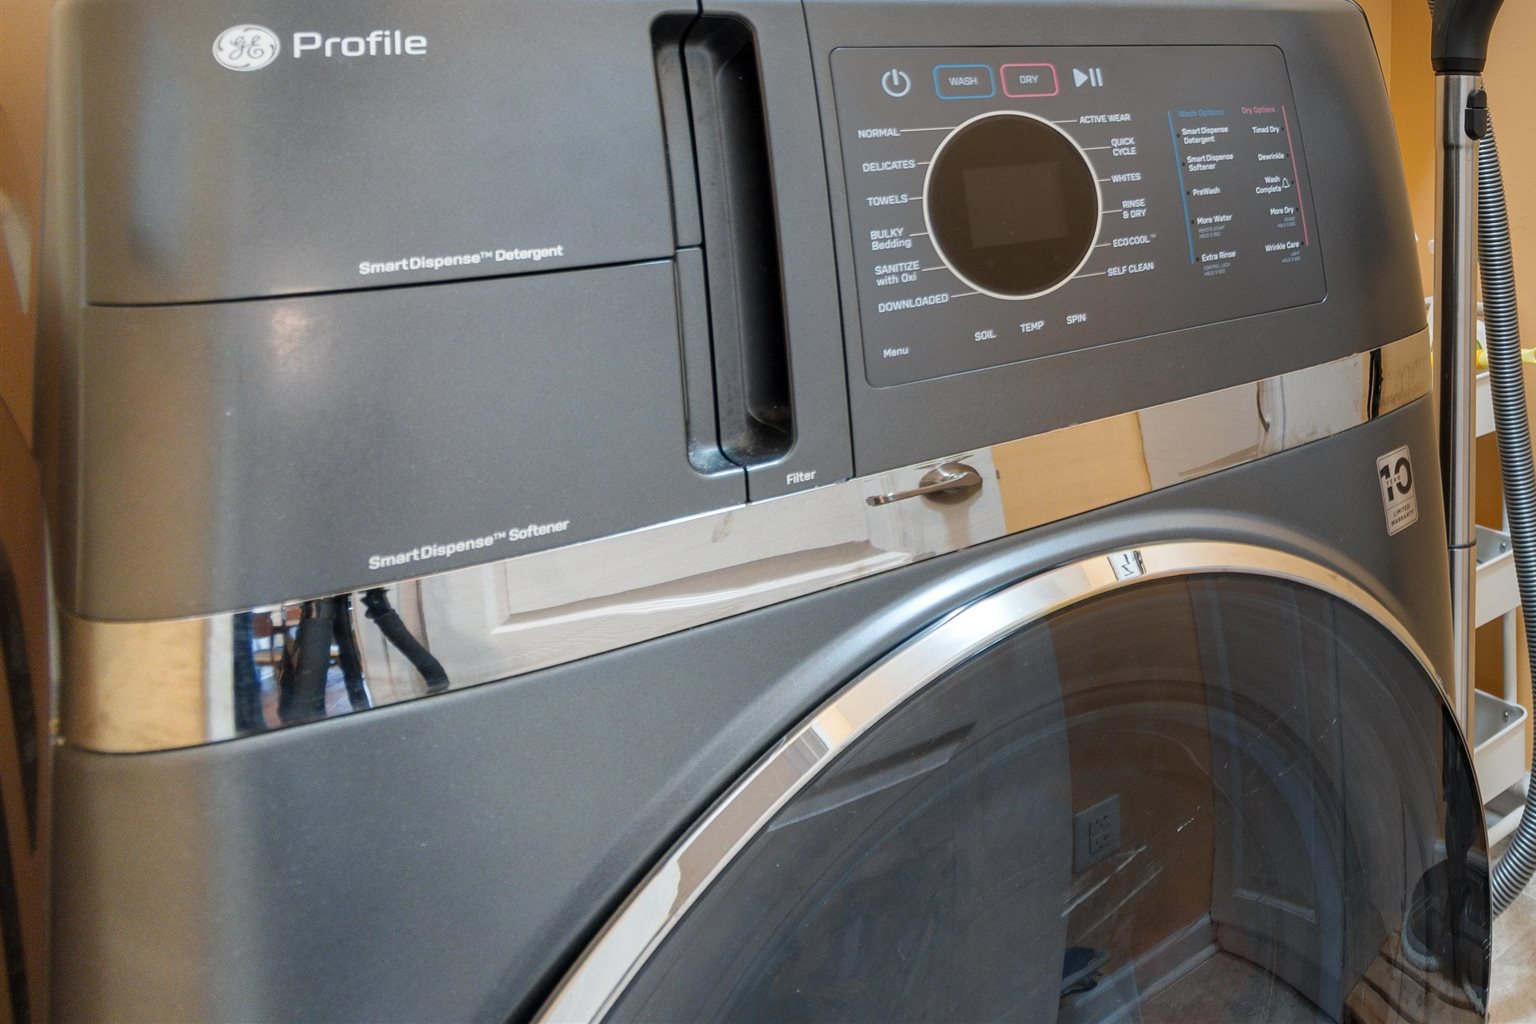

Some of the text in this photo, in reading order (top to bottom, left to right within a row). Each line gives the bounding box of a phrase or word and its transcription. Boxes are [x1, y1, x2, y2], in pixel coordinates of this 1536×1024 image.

[293, 30, 428, 59] Profile
[949, 76, 978, 87] WASH
[1019, 75, 1039, 85] DRY
[1241, 105, 1276, 115] Dry Options
[1079, 113, 1131, 125] ACTIVE WEAR
[857, 127, 900, 139] NORMAL
[1252, 125, 1280, 135] Timed Dry
[1111, 137, 1136, 147] QUICK
[1184, 135, 1215, 145] Detergent
[1113, 146, 1137, 156] CYCLE
[1257, 152, 1285, 161] Dewrinkle
[862, 159, 916, 172] DELICATES
[1188, 163, 1216, 172] Softener
[1111, 173, 1141, 183] WHITES
[1264, 176, 1281, 184] Wash
[1192, 187, 1220, 197] PreWash
[1255, 185, 1282, 194] Complete
[866, 194, 909, 206] TOWELS
[1122, 199, 1146, 209] RINSE
[1122, 208, 1147, 219] & DRY
[1270, 206, 1294, 216] More Dry
[1197, 214, 1233, 225] More Water
[870, 228, 904, 240] BULKY
[871, 237, 912, 251] Bedding
[1265, 240, 1300, 252] Wrinkle Care
[495, 244, 565, 263] Detergent
[1201, 250, 1237, 262] Extra Rinse
[874, 261, 920, 275] SANITIZE
[1107, 262, 1155, 277] SELF CLEAN
[876, 272, 917, 286] with Oxi
[878, 293, 949, 313] DOWNLOADED
[1066, 313, 1088, 325] SPIN
[1019, 320, 1045, 333] TEMP
[974, 328, 997, 342] SOIL
[883, 346, 910, 359] Menu
[786, 469, 817, 486] Filter
[1380, 457, 1412, 502] 10
[1393, 503, 1411, 518] LIMITED
[1390, 509, 1415, 527] WARRANTY
[508, 519, 571, 542] Softener
